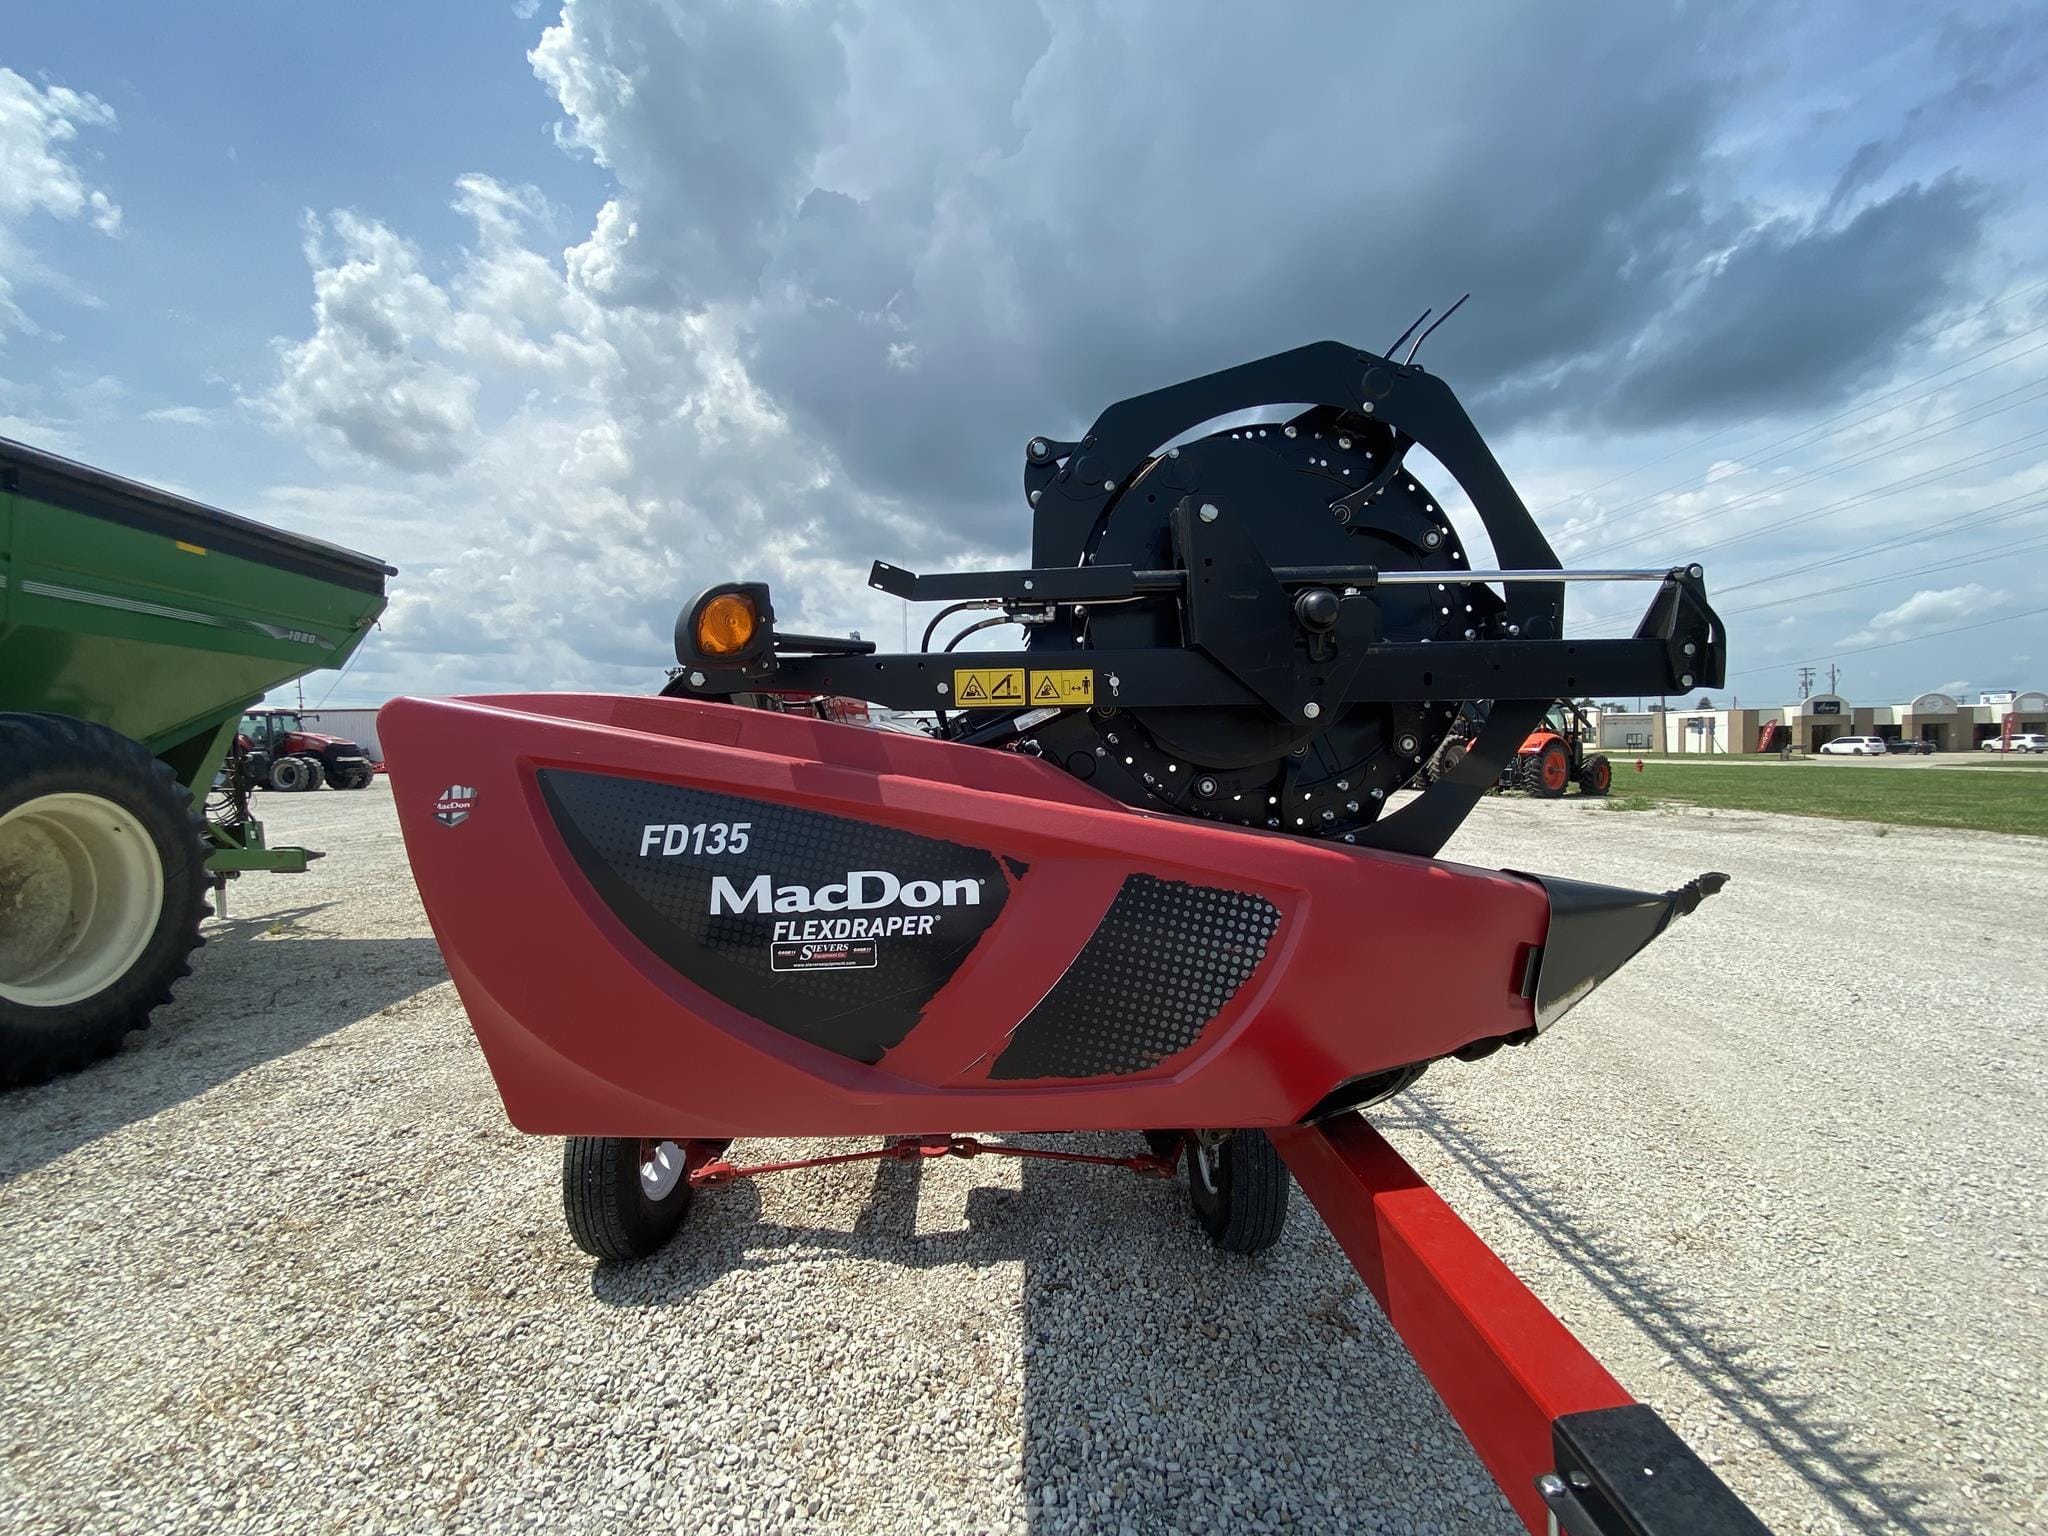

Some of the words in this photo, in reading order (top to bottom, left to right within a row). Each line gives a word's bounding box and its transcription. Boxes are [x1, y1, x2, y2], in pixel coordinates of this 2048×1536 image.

[639, 822, 752, 857] FD135
[710, 871, 981, 915] MacDon
[800, 943, 849, 961] SIEVERS
